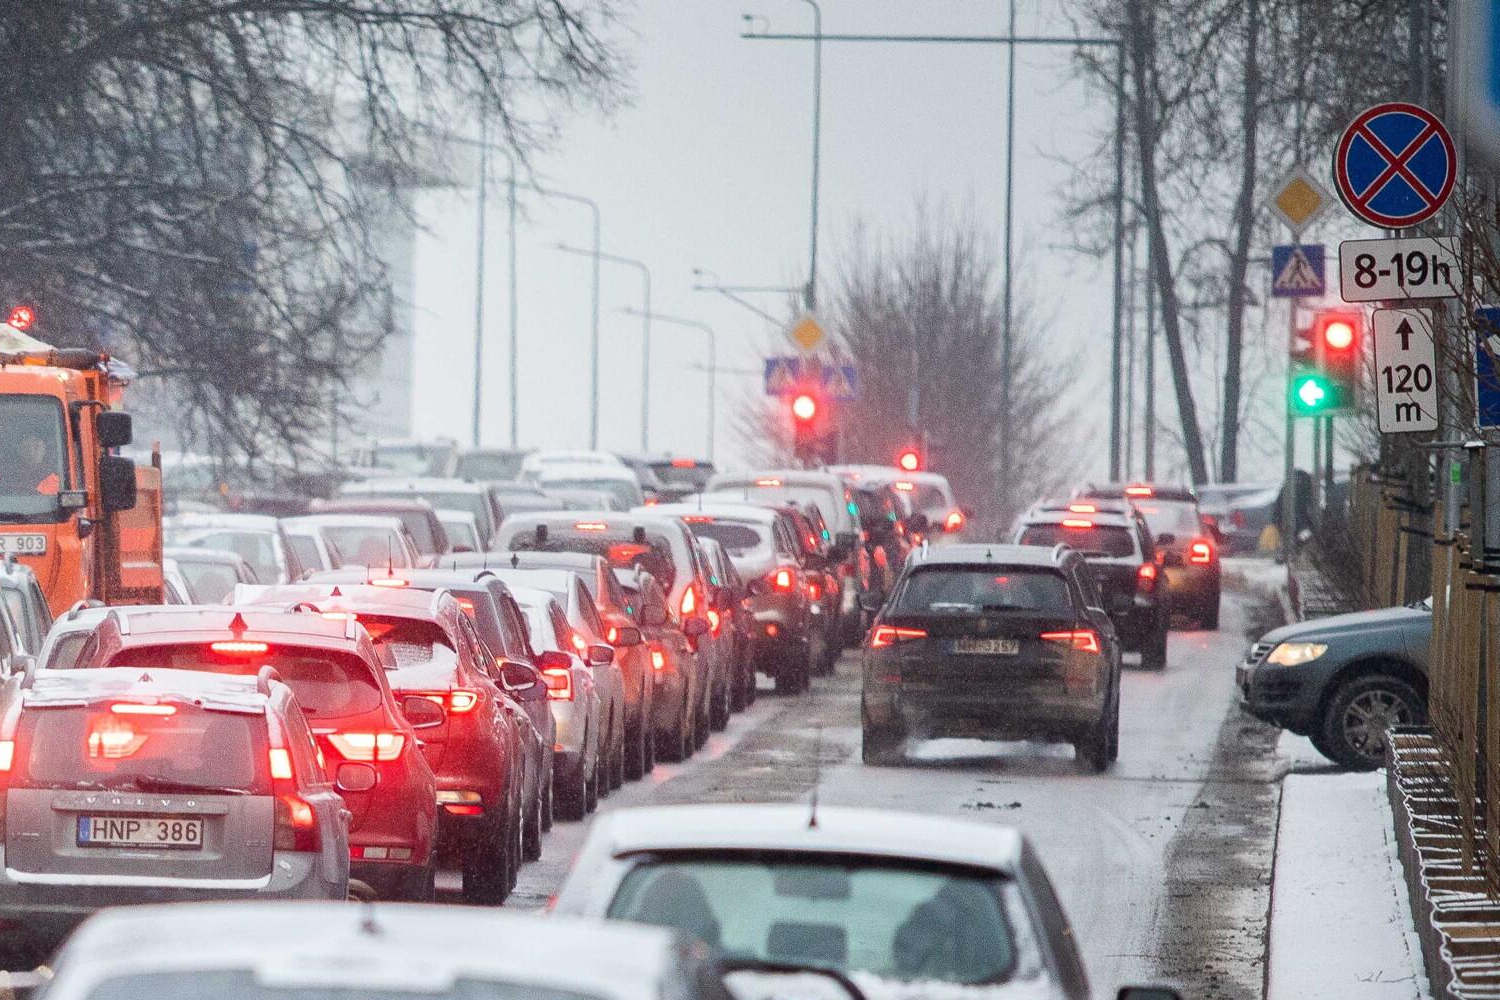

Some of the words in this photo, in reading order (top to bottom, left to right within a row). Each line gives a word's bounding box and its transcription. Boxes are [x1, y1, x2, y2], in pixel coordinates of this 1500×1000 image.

[1354, 250, 1450, 289] 8-19h
[1382, 364, 1432, 393] 120
[1395, 401, 1422, 423] m
[16, 537, 44, 551] 903
[87, 797, 196, 808] VOLVO
[93, 820, 141, 840] HNP
[157, 822, 198, 842] 386
